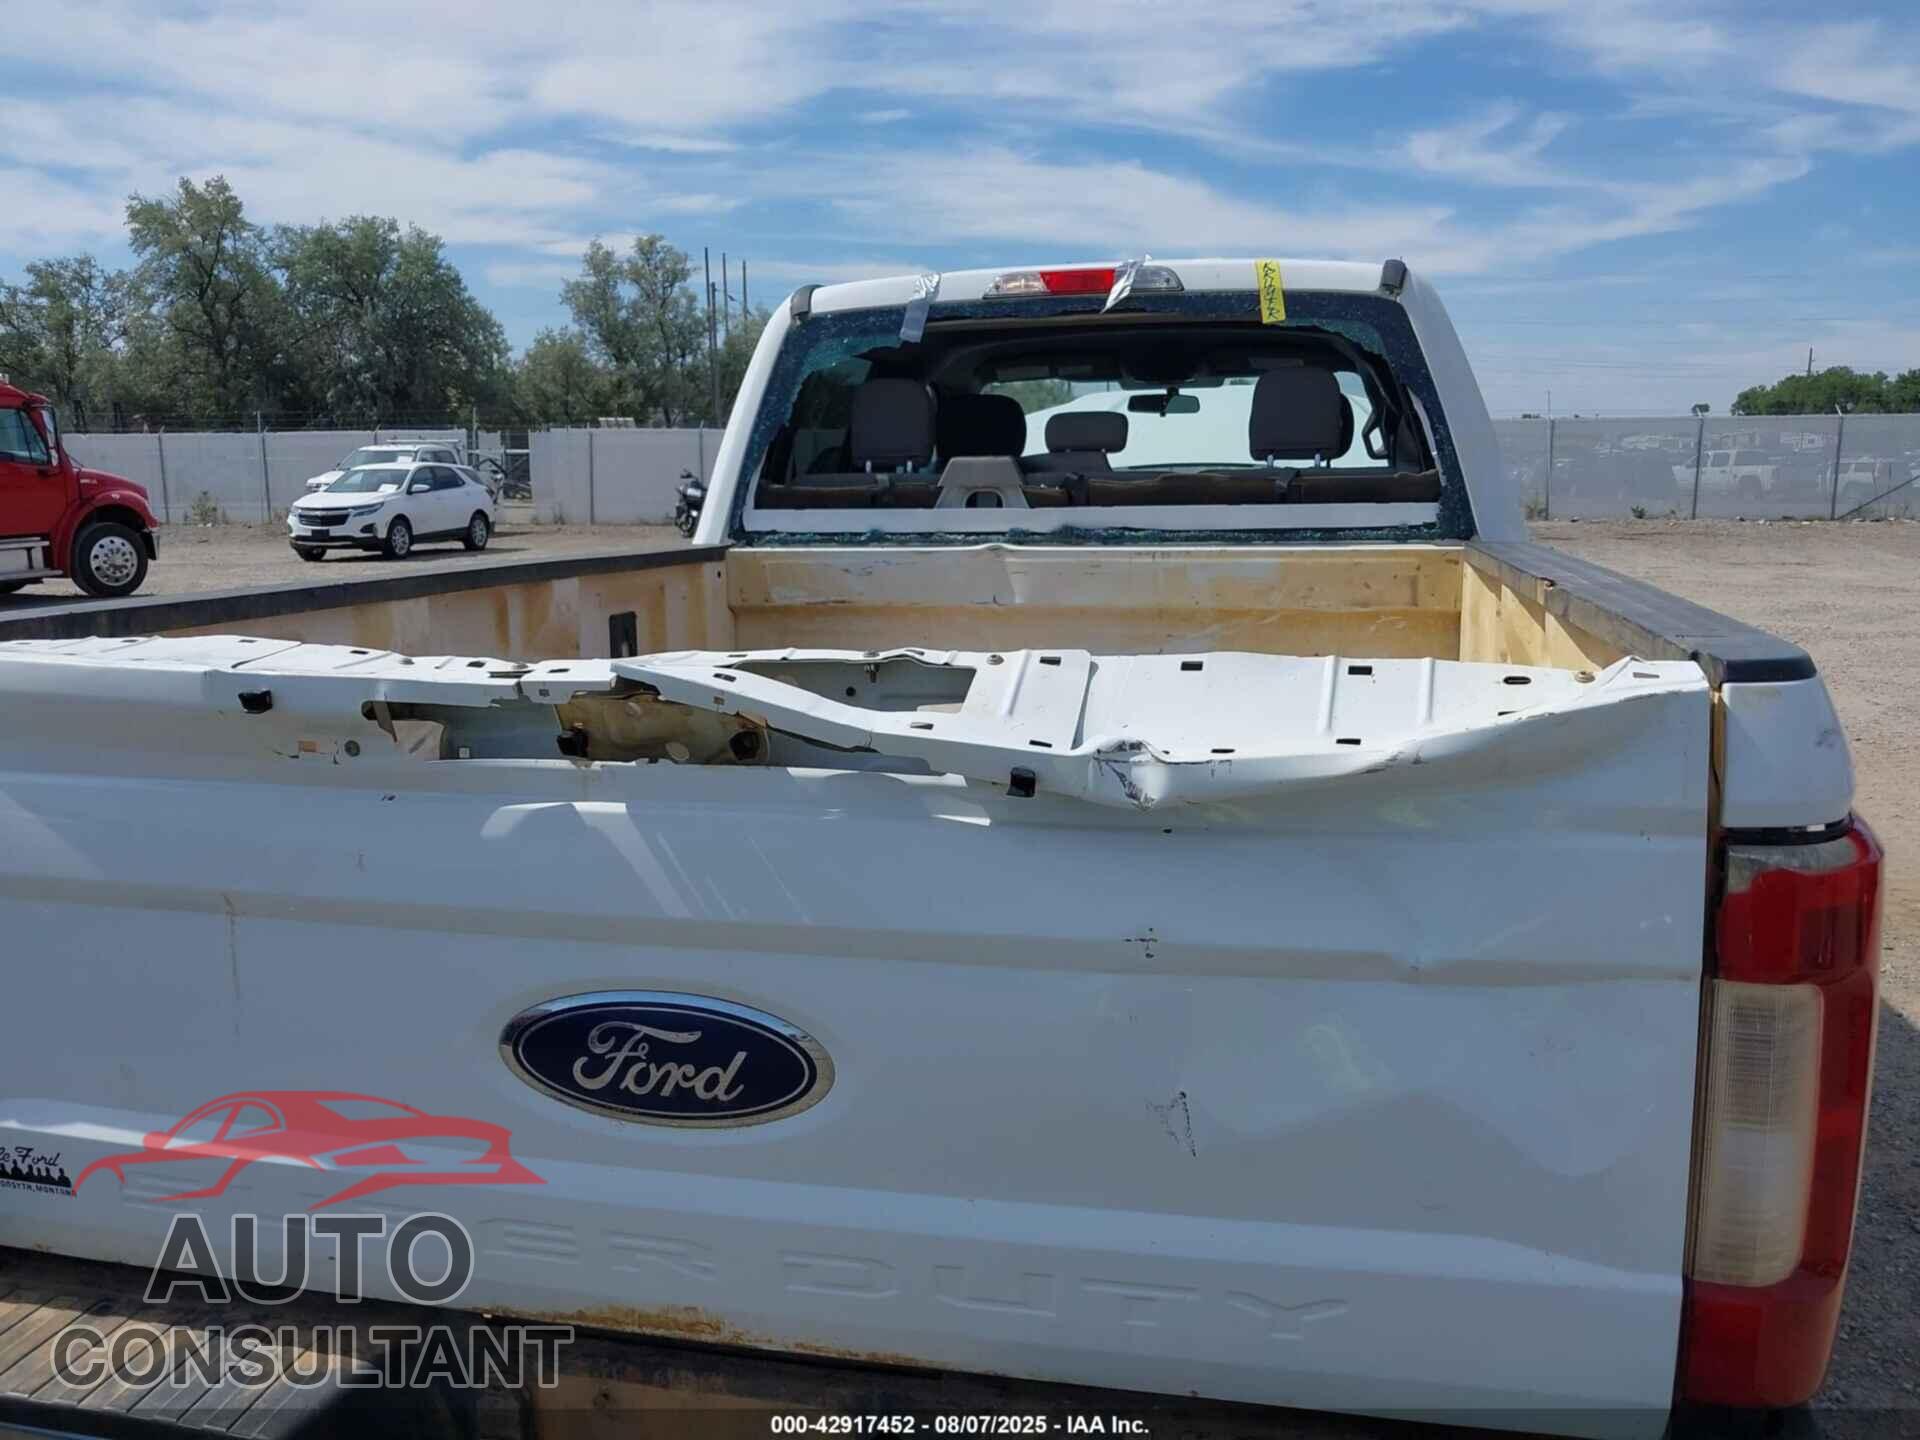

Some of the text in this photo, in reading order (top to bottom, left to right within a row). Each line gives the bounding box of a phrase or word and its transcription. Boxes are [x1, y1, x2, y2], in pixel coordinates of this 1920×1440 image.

[572, 1020, 748, 1102] Ford
[15, 1147, 60, 1166] Ford
[781, 1251, 1349, 1339] DUTY
